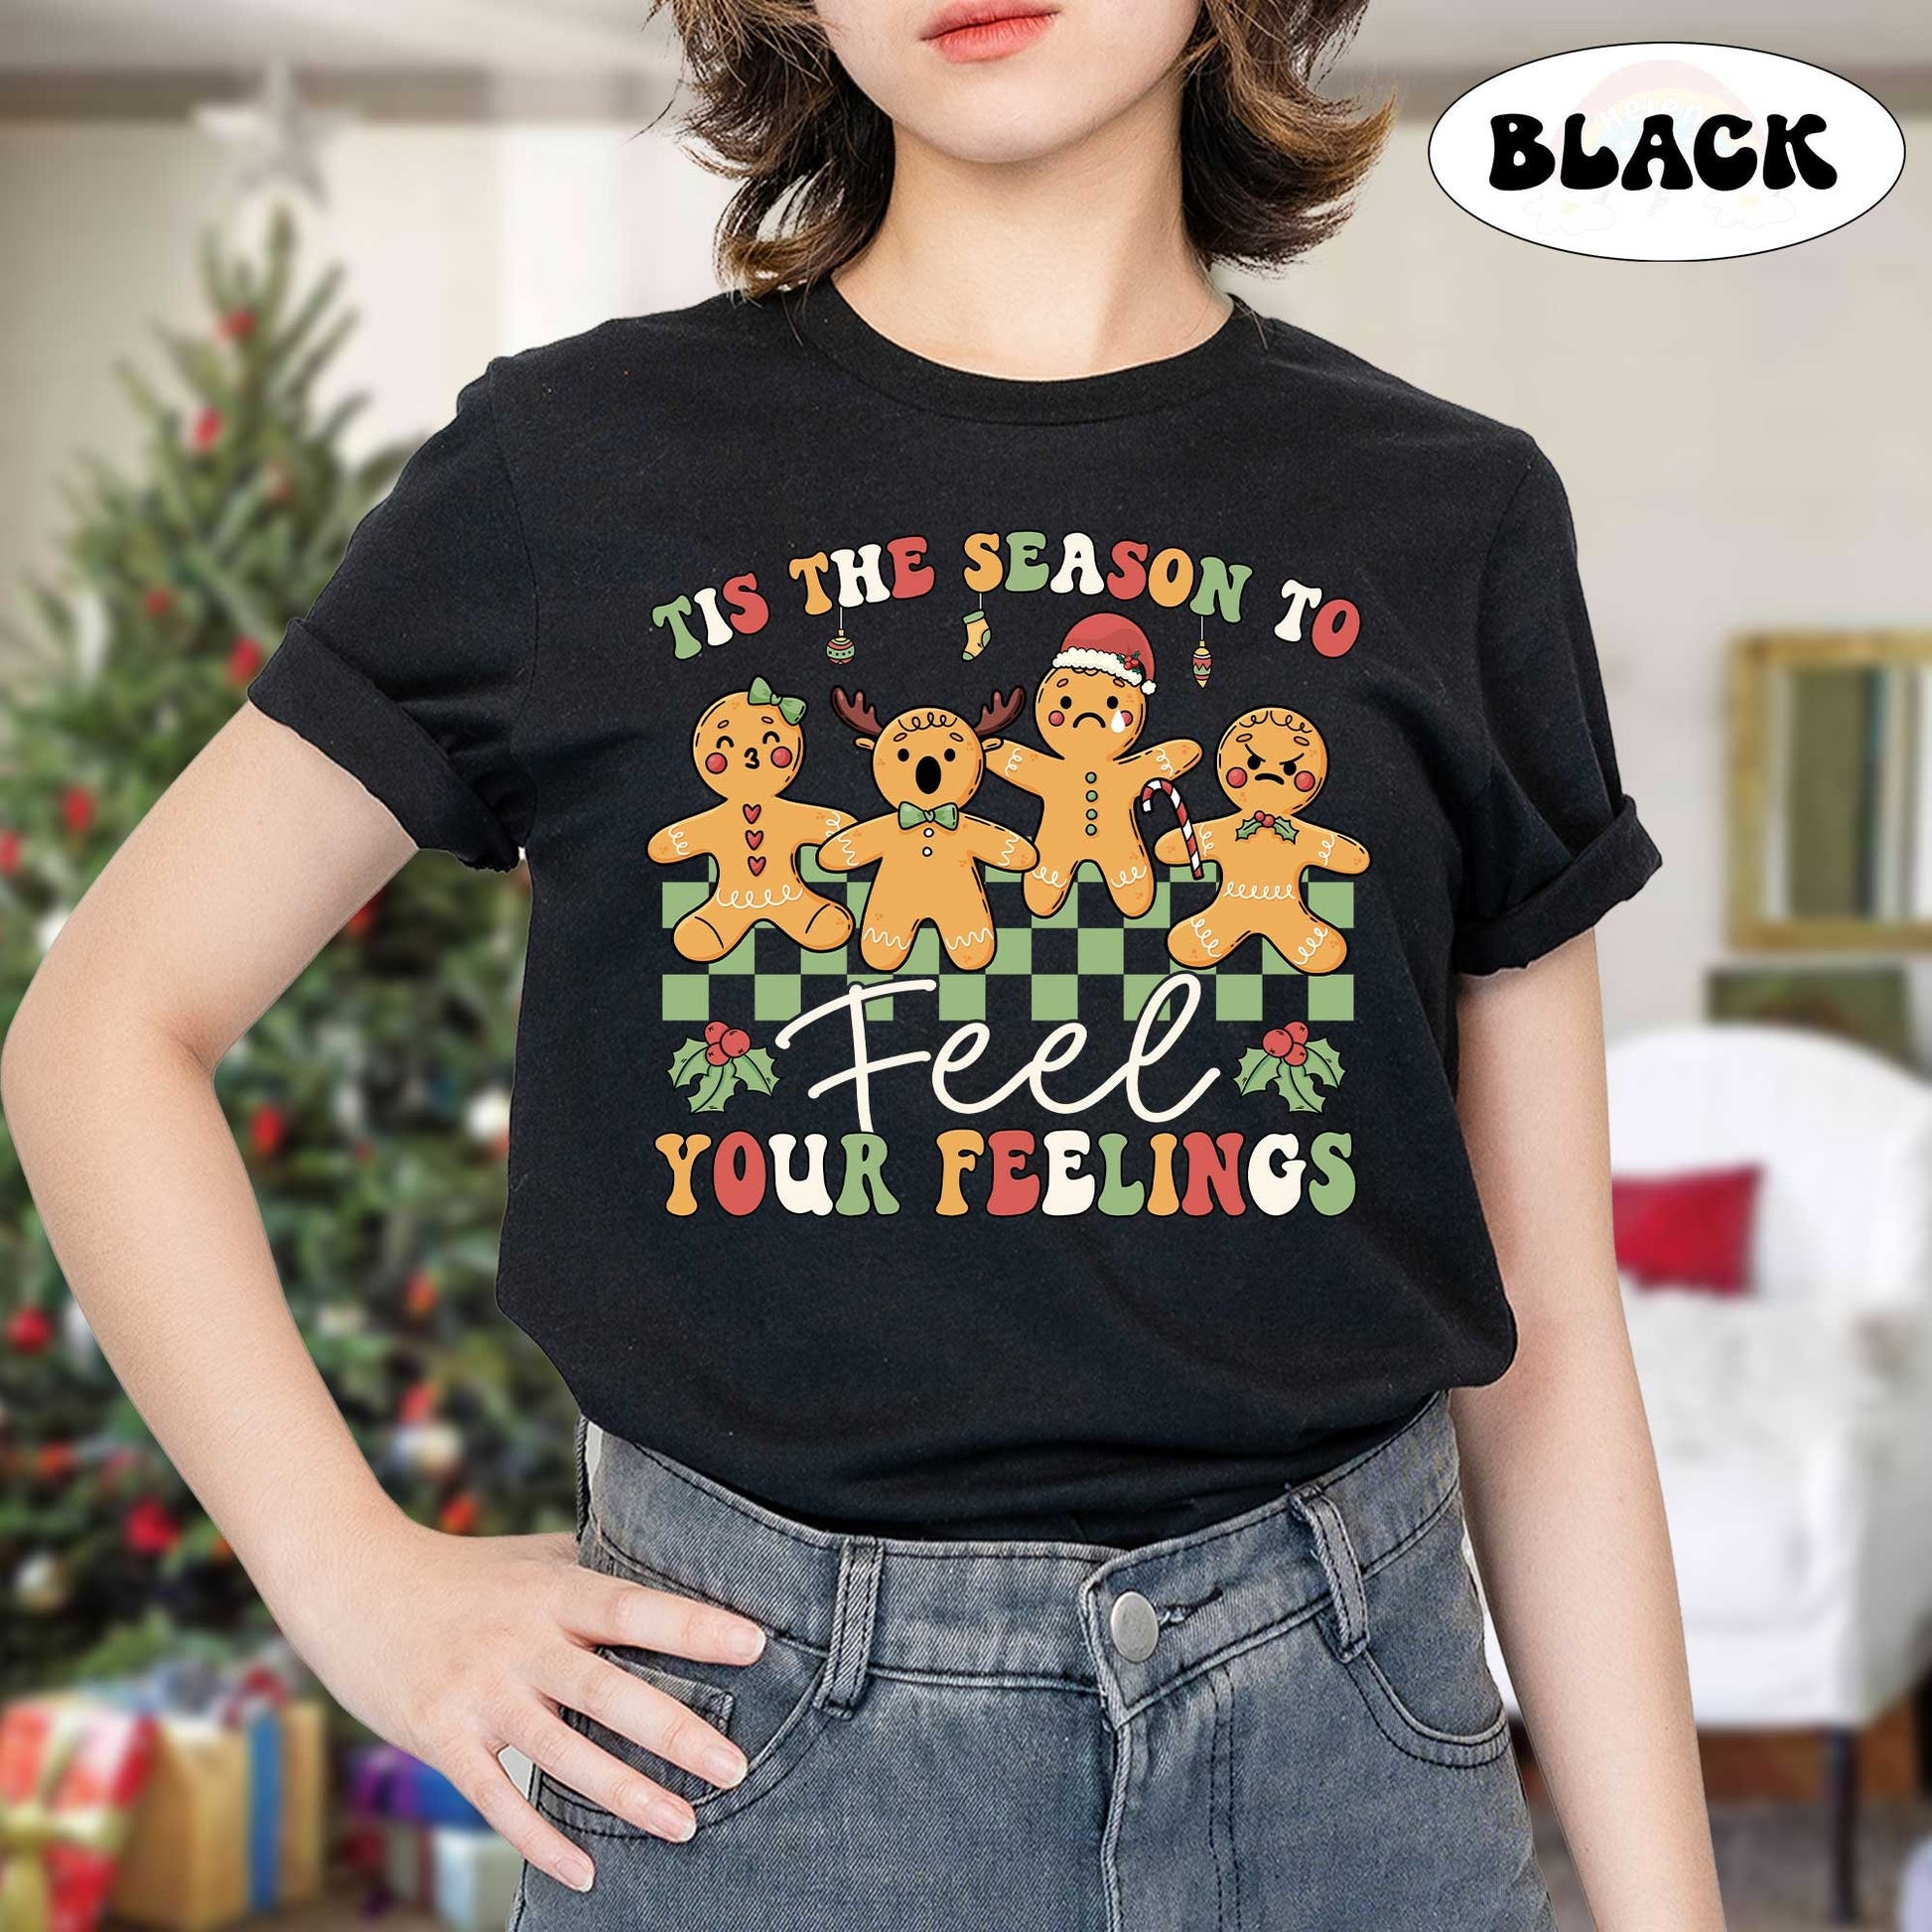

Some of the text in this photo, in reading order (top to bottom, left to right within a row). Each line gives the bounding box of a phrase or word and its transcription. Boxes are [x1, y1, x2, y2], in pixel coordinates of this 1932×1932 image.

[652, 531, 1361, 660] TIS THE SEASON TO
[774, 973, 1221, 1132] Feel
[654, 1130, 1356, 1216] YOUR FEELINGS
